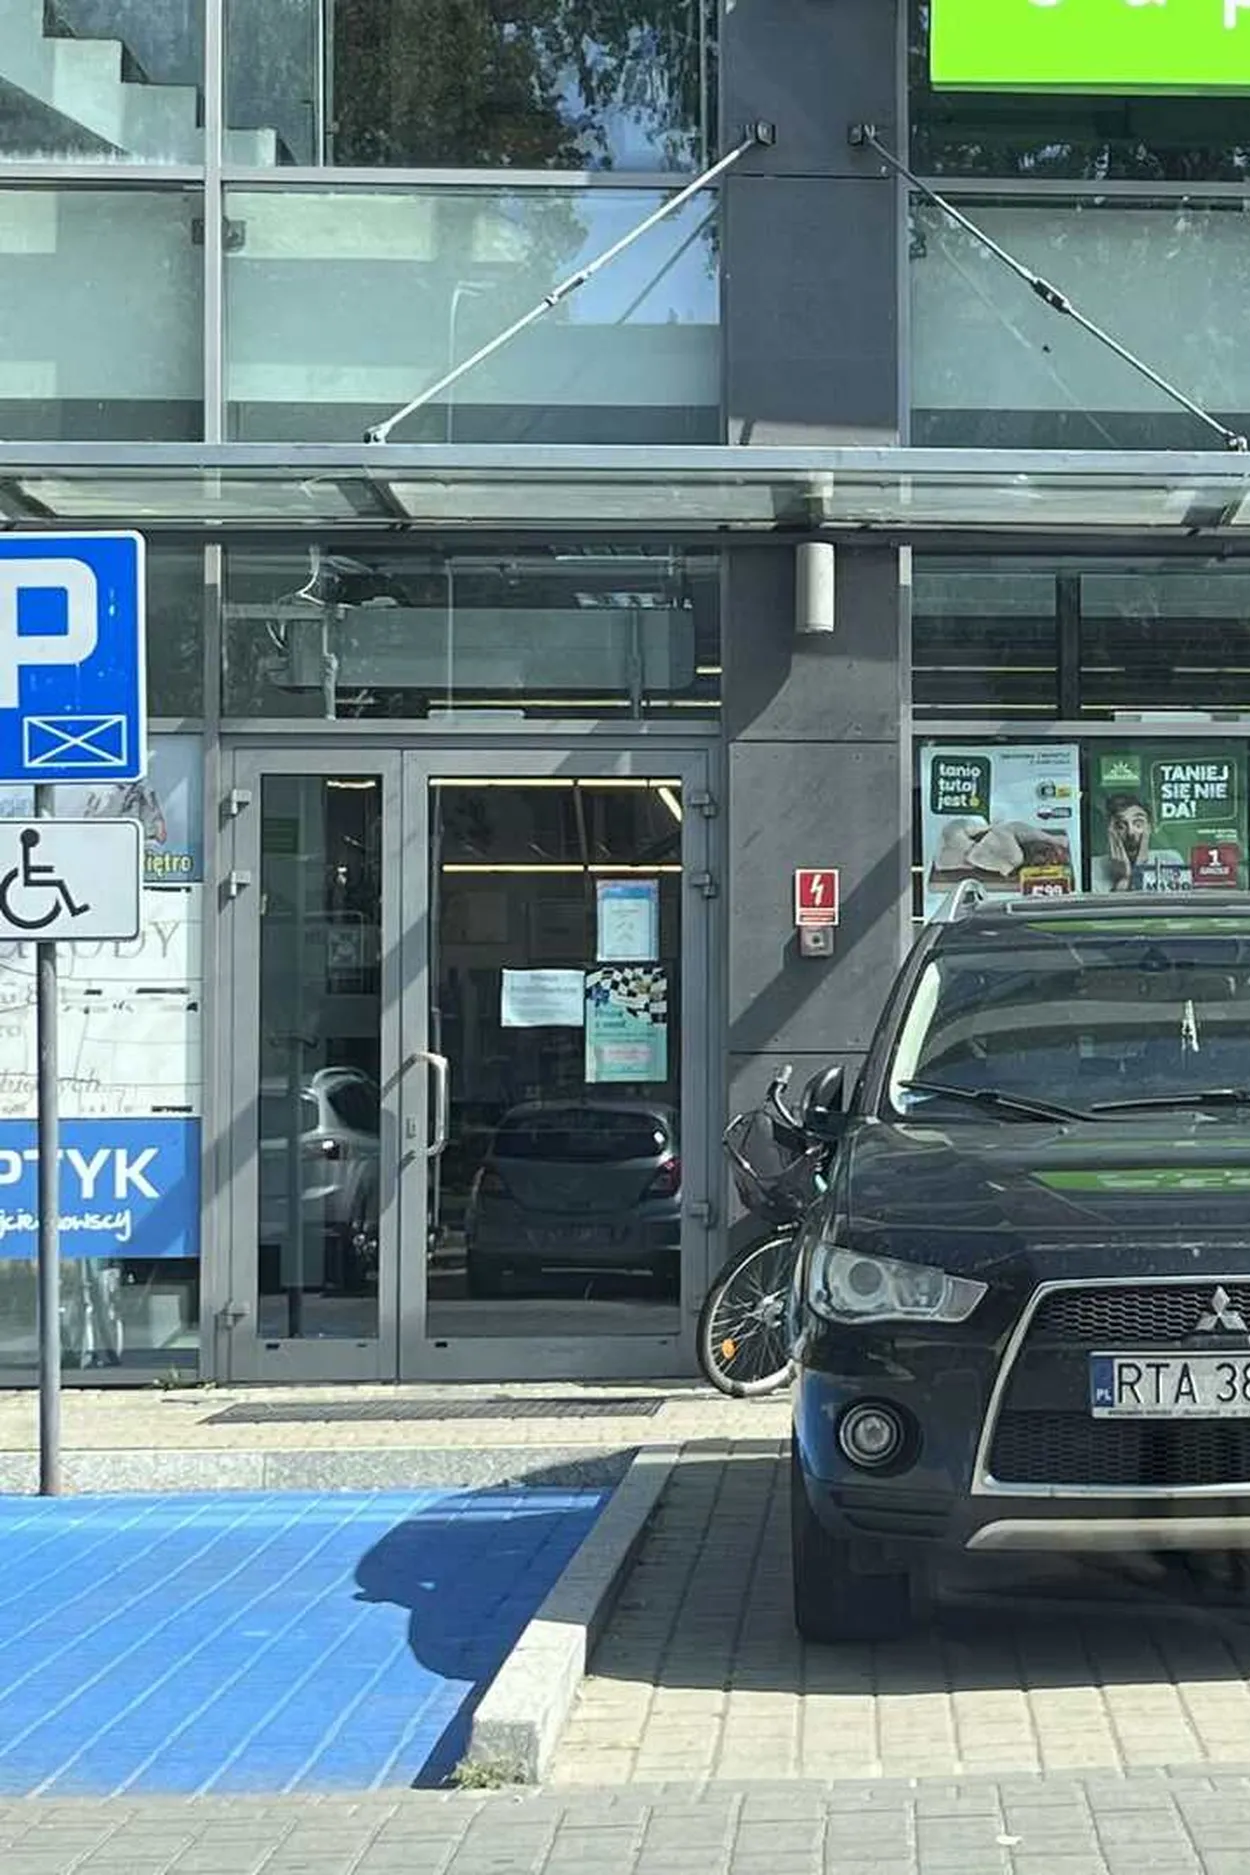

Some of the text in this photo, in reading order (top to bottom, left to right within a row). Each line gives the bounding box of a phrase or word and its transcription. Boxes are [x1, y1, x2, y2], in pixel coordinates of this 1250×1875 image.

[0, 557, 98, 708] P
[939, 762, 982, 778] tanio
[1160, 764, 1229, 782] TANIEJ
[938, 778, 977, 798] tutaj
[1161, 783, 1227, 802] SIĘ NIE
[937, 792, 967, 810] jest
[1161, 800, 1197, 818] DA!
[144, 851, 192, 877] iętro
[1208, 849, 1221, 866] 1
[1117, 1362, 1199, 1404] RTA
[1096, 1388, 1112, 1401] PL
